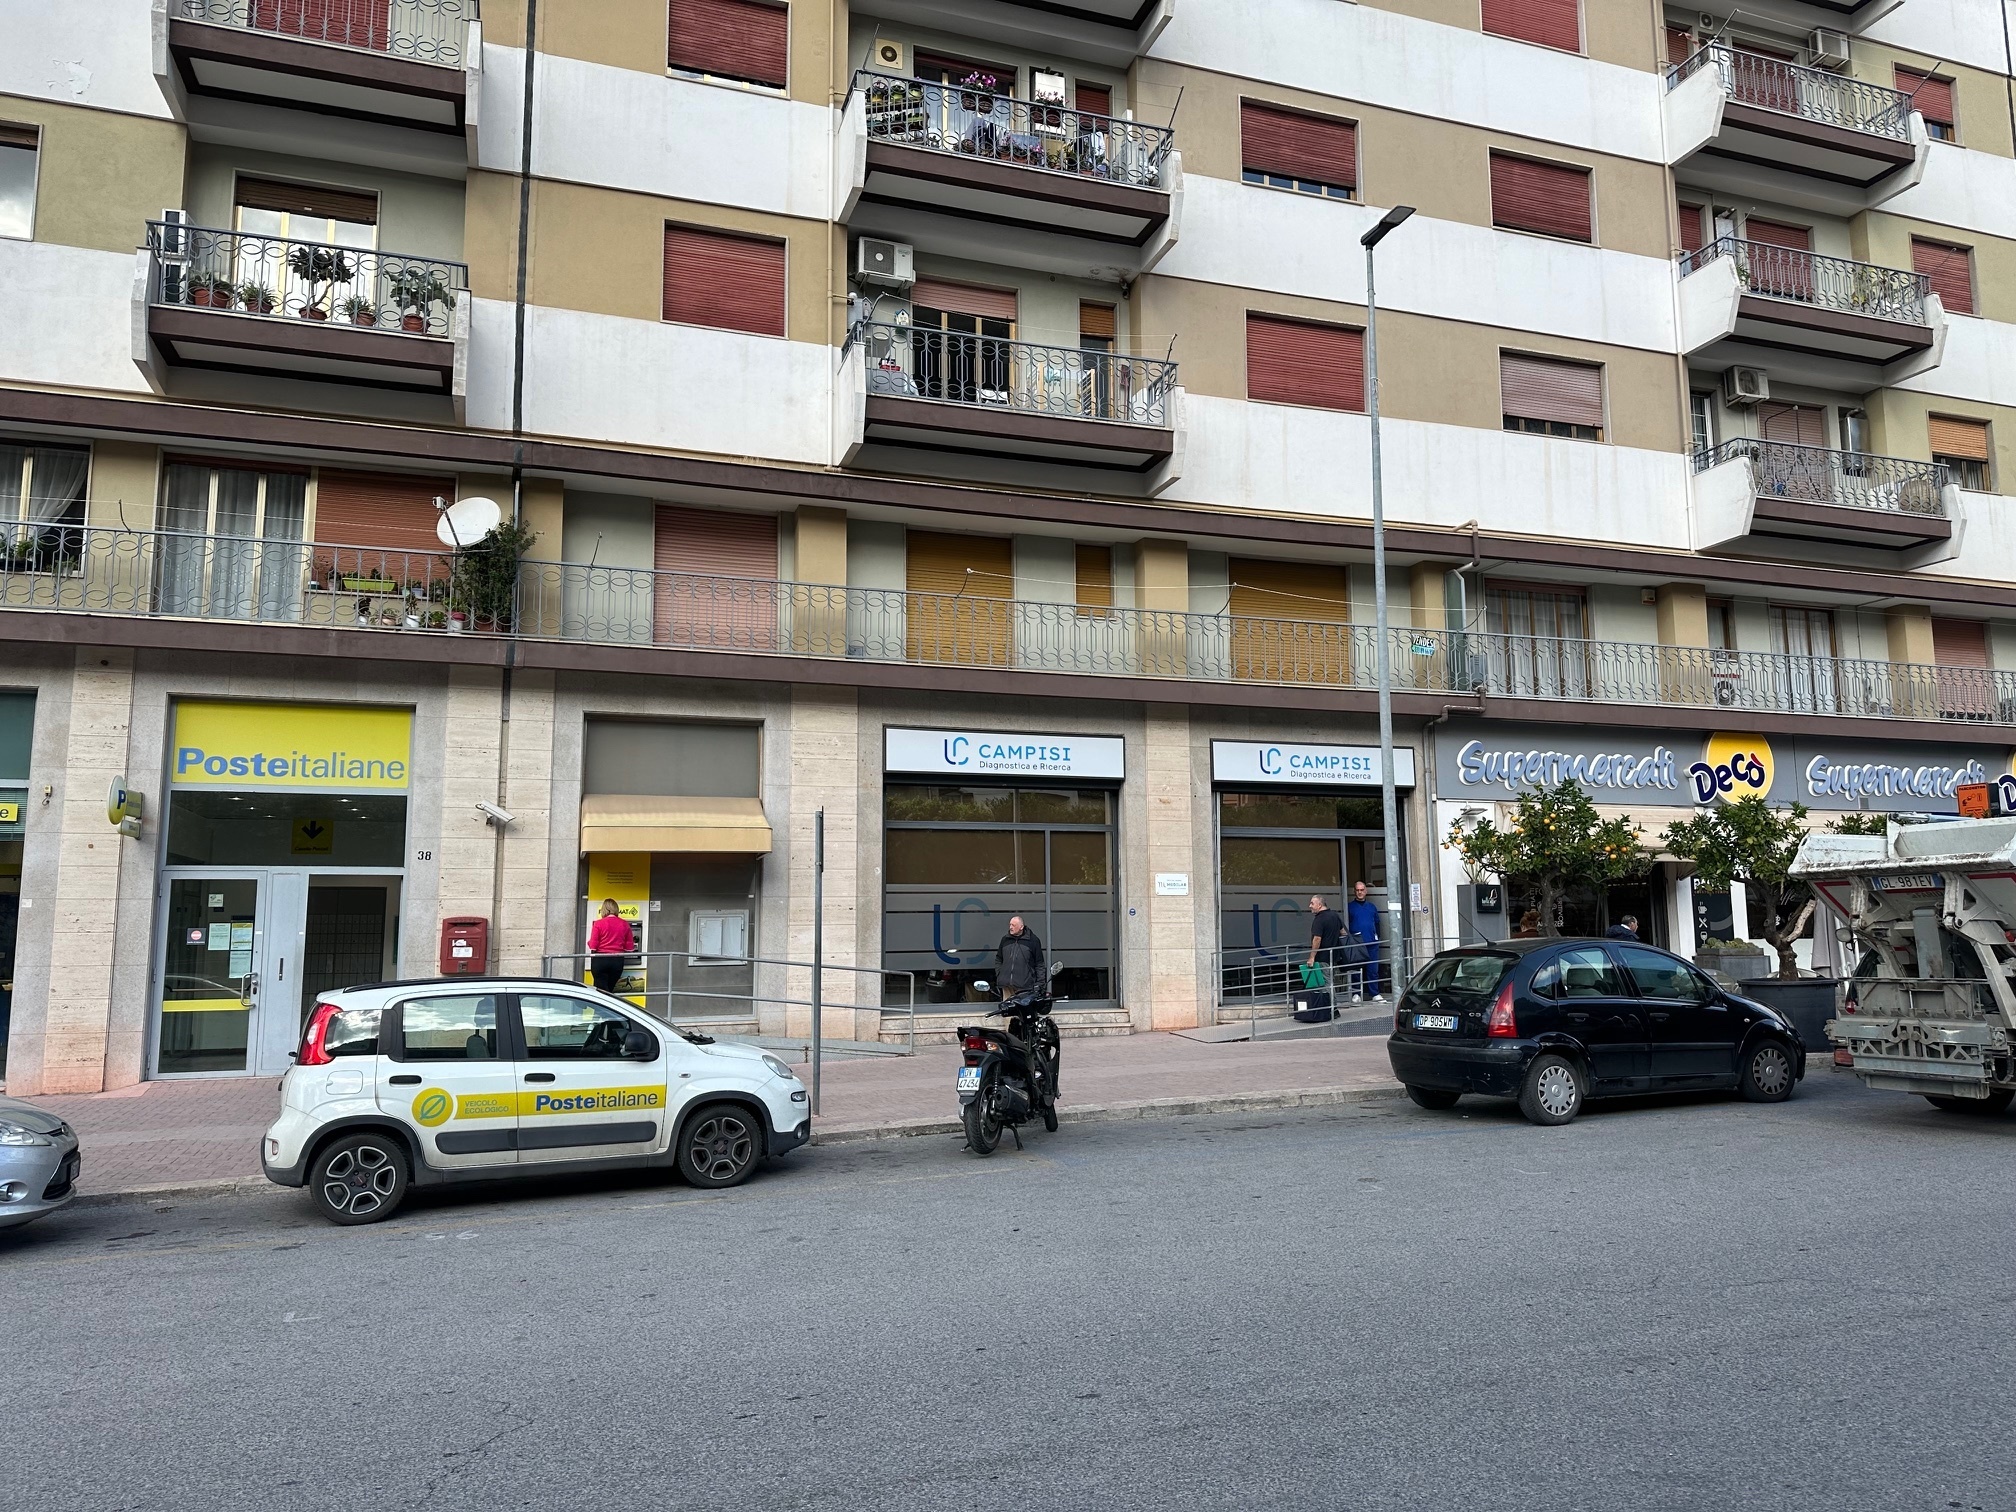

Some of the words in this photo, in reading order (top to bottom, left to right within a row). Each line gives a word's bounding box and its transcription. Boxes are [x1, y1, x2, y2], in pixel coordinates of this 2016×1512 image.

[979, 744, 1071, 761] CAMPISI
[177, 747, 405, 780] Posteitaliane
[979, 761, 1031, 771] Diagnostica
[1040, 763, 1071, 771] Ricerca
[1290, 755, 1371, 770] CAMPISI
[1457, 739, 1679, 790] Supermercati
[1290, 770, 1335, 779] Diagnostica
[417, 850, 432, 861] 38
[1881, 877, 1896, 888] GL
[1898, 874, 1933, 887] 981EV
[1420, 1016, 1429, 1026] DP
[1430, 1016, 1453, 1028] 905WM
[464, 1099, 498, 1107] VEICOLO
[536, 1091, 658, 1111] Posteitaliane
[464, 1106, 509, 1115] ECOLOGICO
